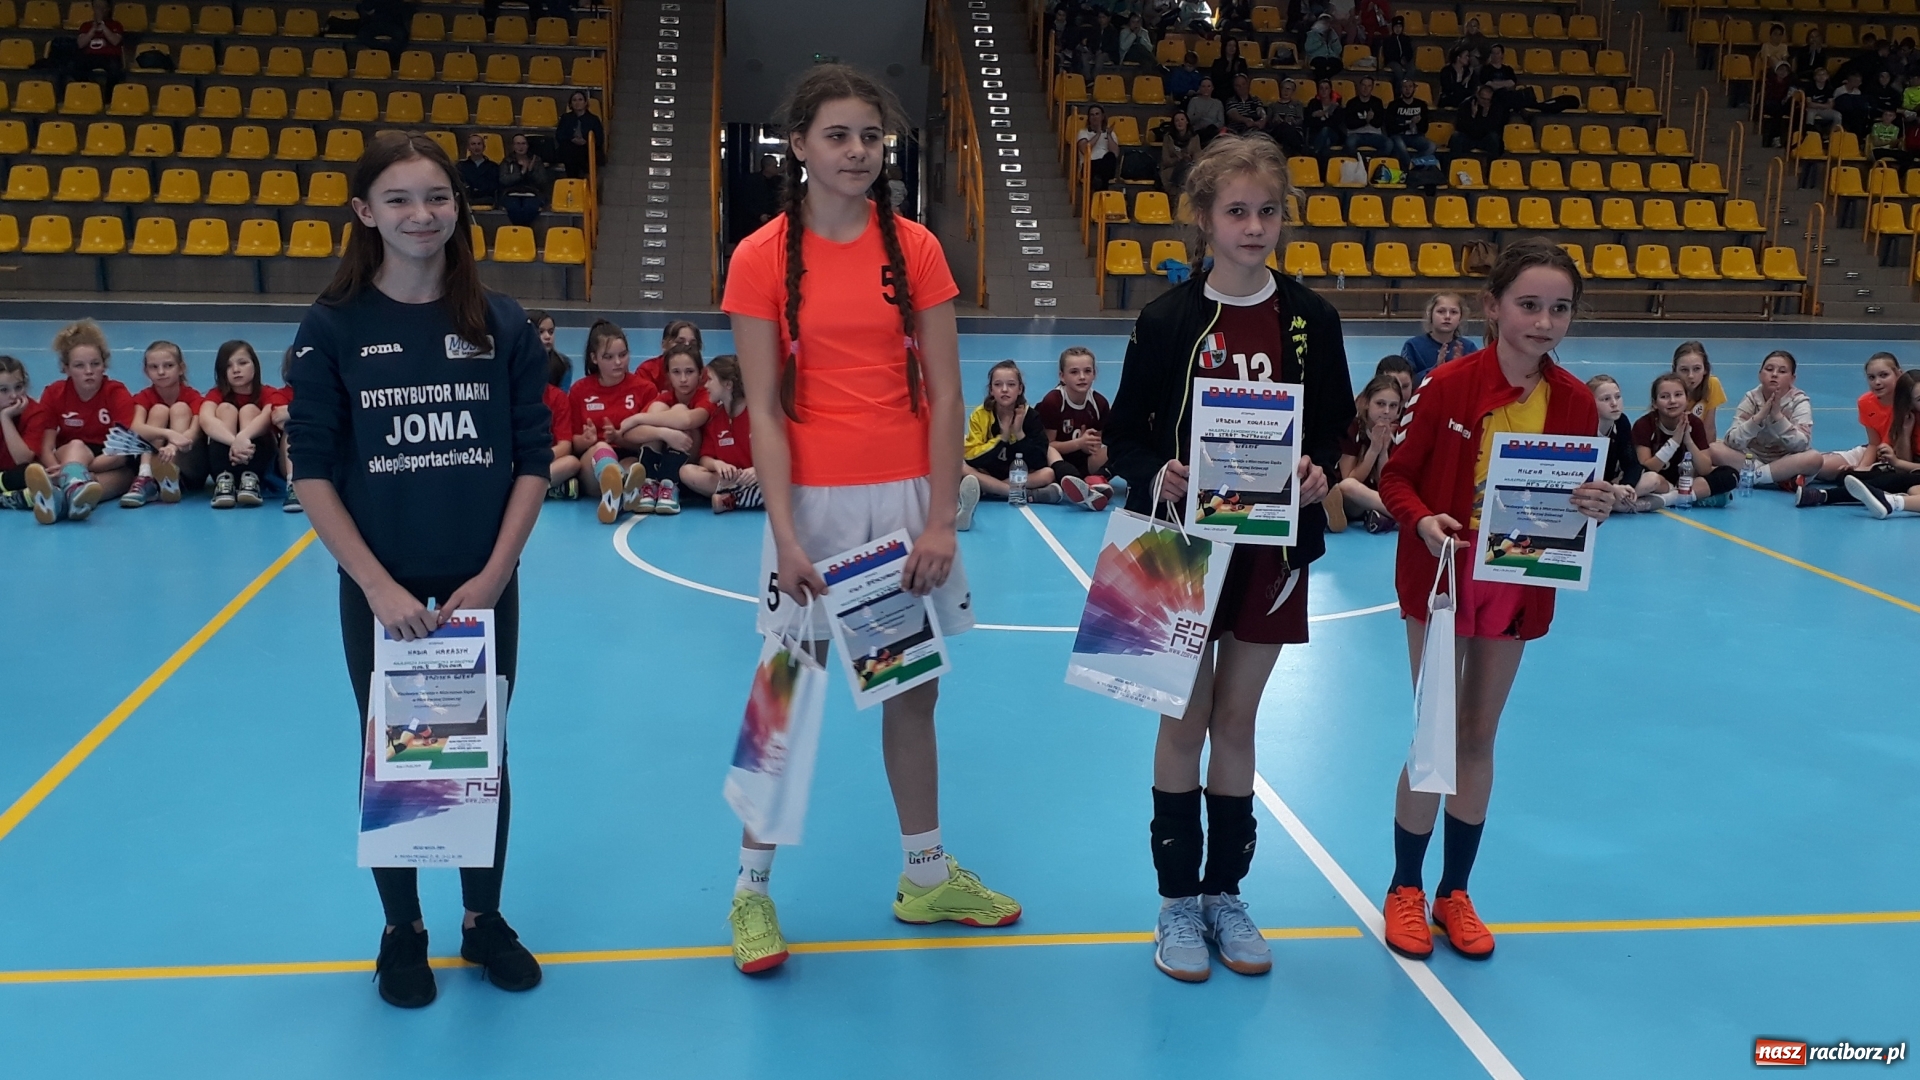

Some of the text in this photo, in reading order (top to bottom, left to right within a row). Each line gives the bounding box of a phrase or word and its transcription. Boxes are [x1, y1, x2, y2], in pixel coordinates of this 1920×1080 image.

[360, 343, 403, 357] joma
[1232, 352, 1275, 383] 13
[360, 383, 490, 408] DYSTRYBUTOR MARKI
[624, 395, 635, 409] 5
[1209, 386, 1288, 401] DYPLOM
[98, 408, 111, 425] 6
[385, 410, 478, 446] JOMA
[998, 447, 1007, 461] 4
[1508, 440, 1592, 453] DYPLOM
[368, 447, 494, 475] sklep@sportactive24.pl
[828, 539, 899, 575] DYPLOM
[767, 572, 780, 612] 5
